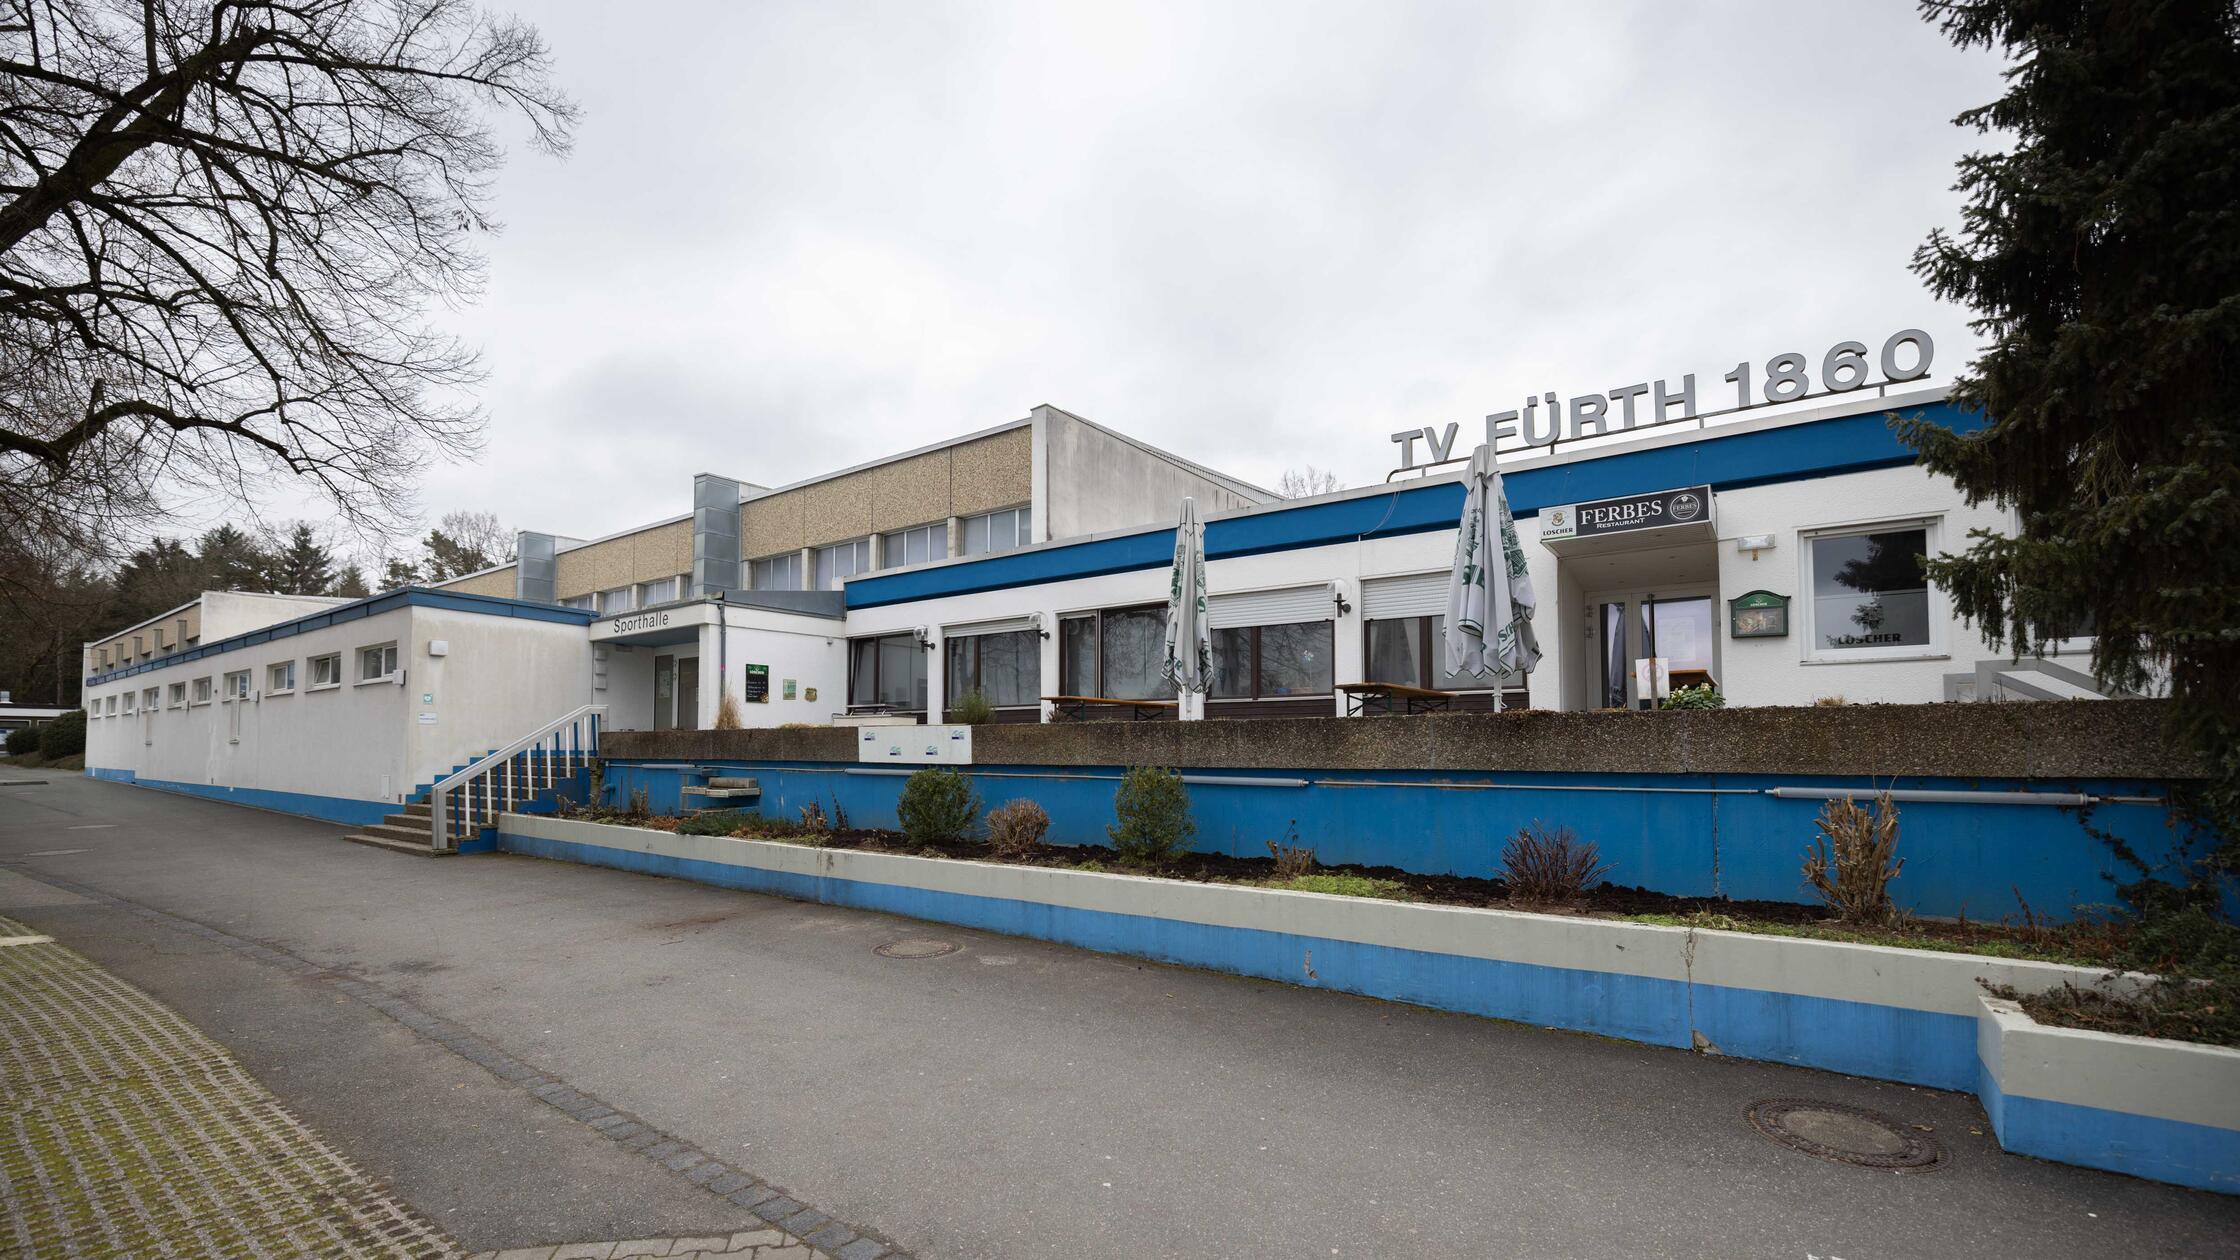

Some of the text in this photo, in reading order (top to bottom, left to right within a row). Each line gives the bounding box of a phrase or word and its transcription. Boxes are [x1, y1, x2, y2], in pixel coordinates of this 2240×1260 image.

[1391, 328, 1935, 469] TV FÜRTH 1860
[1580, 500, 1663, 525] FERBES
[1596, 517, 1646, 529] RESTAURANT
[613, 611, 669, 635] Sporthalle
